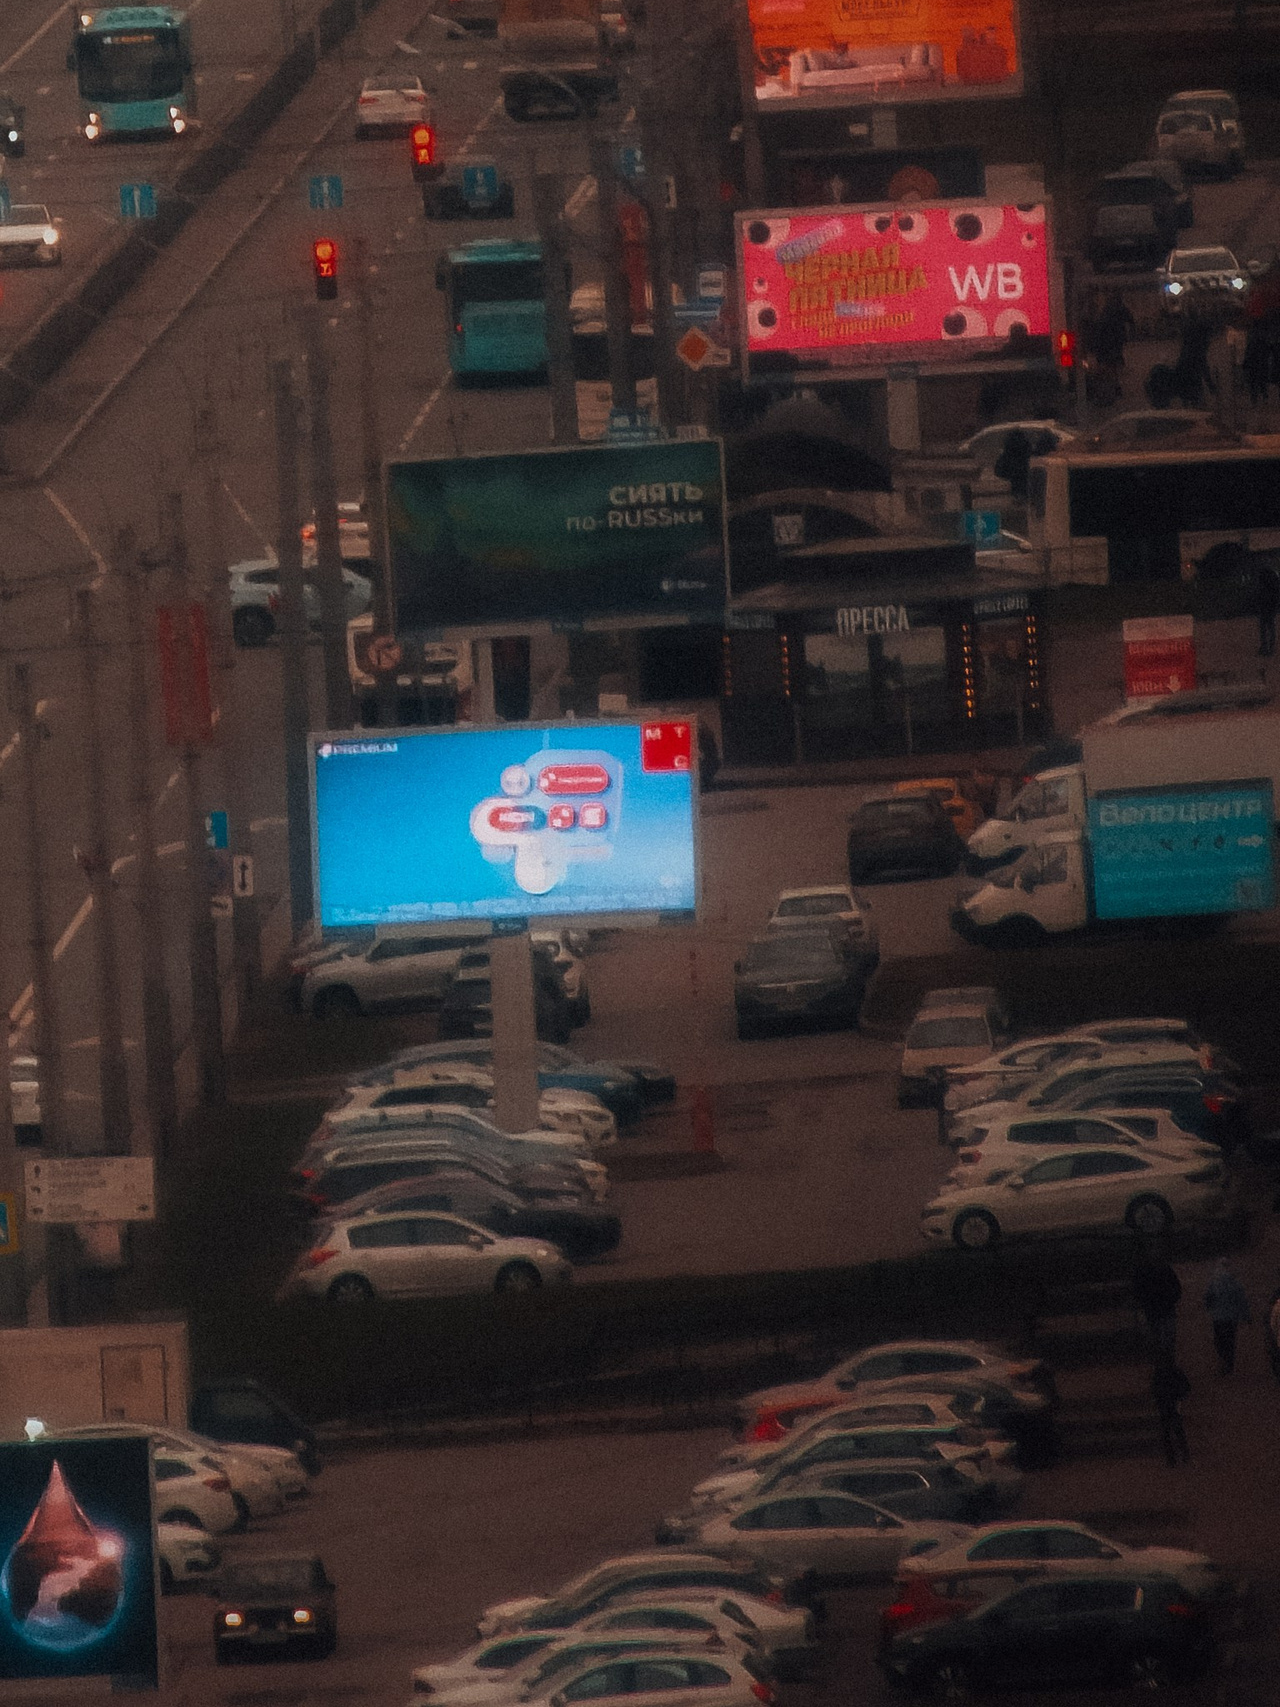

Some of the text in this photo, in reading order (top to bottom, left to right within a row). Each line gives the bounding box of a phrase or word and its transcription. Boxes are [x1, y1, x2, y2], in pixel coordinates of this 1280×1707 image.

[789, 265, 929, 313] ПЯТНИЦА
[948, 262, 1024, 301] WB
[609, 481, 704, 507] СИЯТЬ
[836, 605, 910, 637] ПРЕССА
